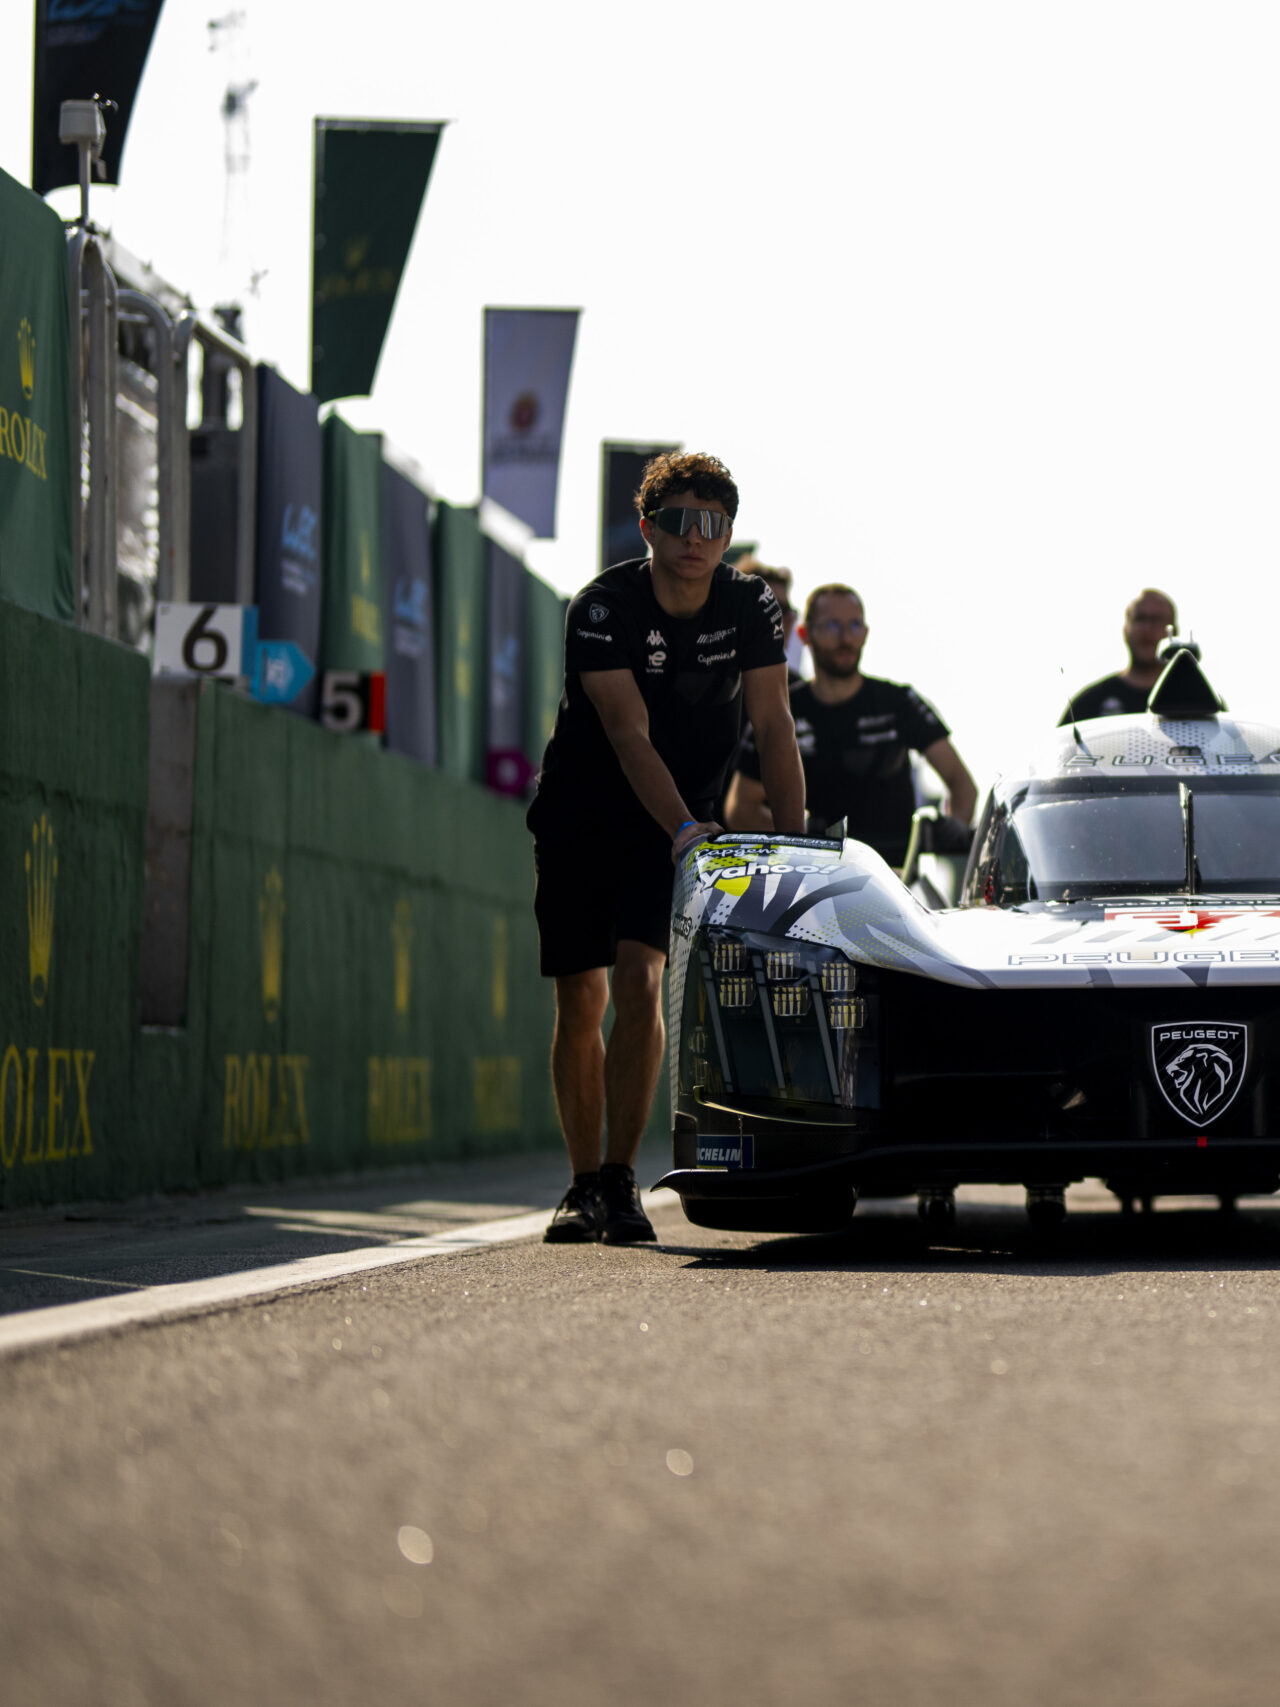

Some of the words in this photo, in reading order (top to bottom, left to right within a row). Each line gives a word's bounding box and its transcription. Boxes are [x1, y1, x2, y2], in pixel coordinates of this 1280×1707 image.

[182, 602, 228, 672] 6
[322, 670, 361, 731] 5
[700, 862, 842, 890] yahoo!
[1160, 1030, 1239, 1041] PEUGEOT
[224, 1052, 310, 1149] ROLEX
